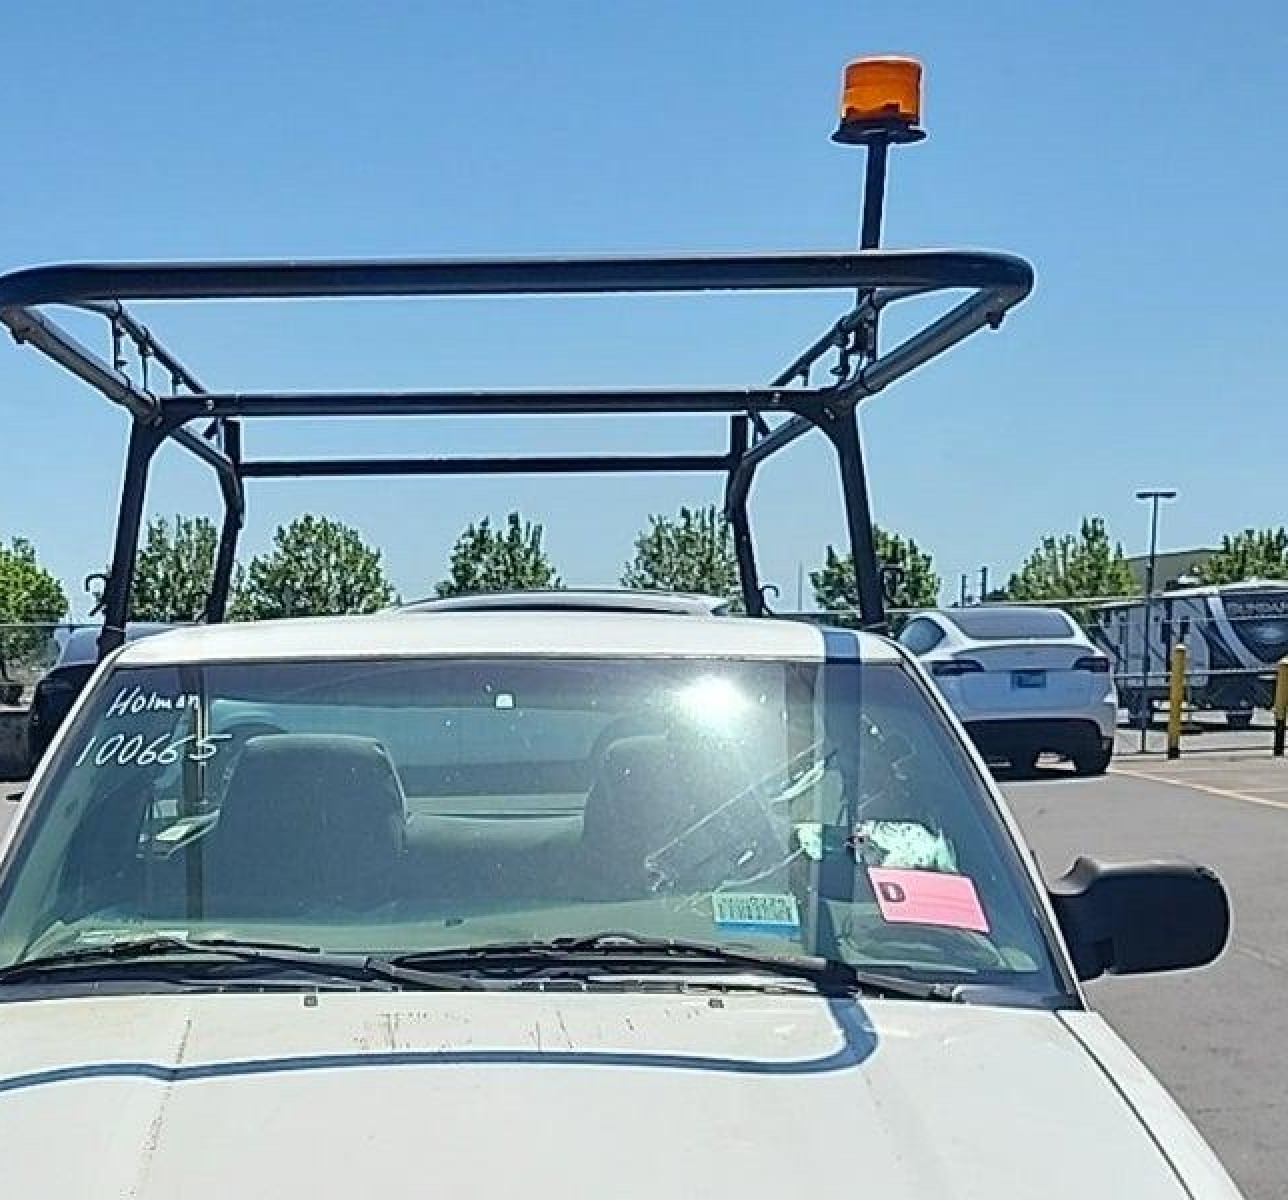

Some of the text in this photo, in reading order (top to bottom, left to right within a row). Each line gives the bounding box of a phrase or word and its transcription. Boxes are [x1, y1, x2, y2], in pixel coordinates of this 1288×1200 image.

[105, 685, 200, 718] Holman
[75, 733, 233, 767] 100665
[878, 881, 906, 902] D
